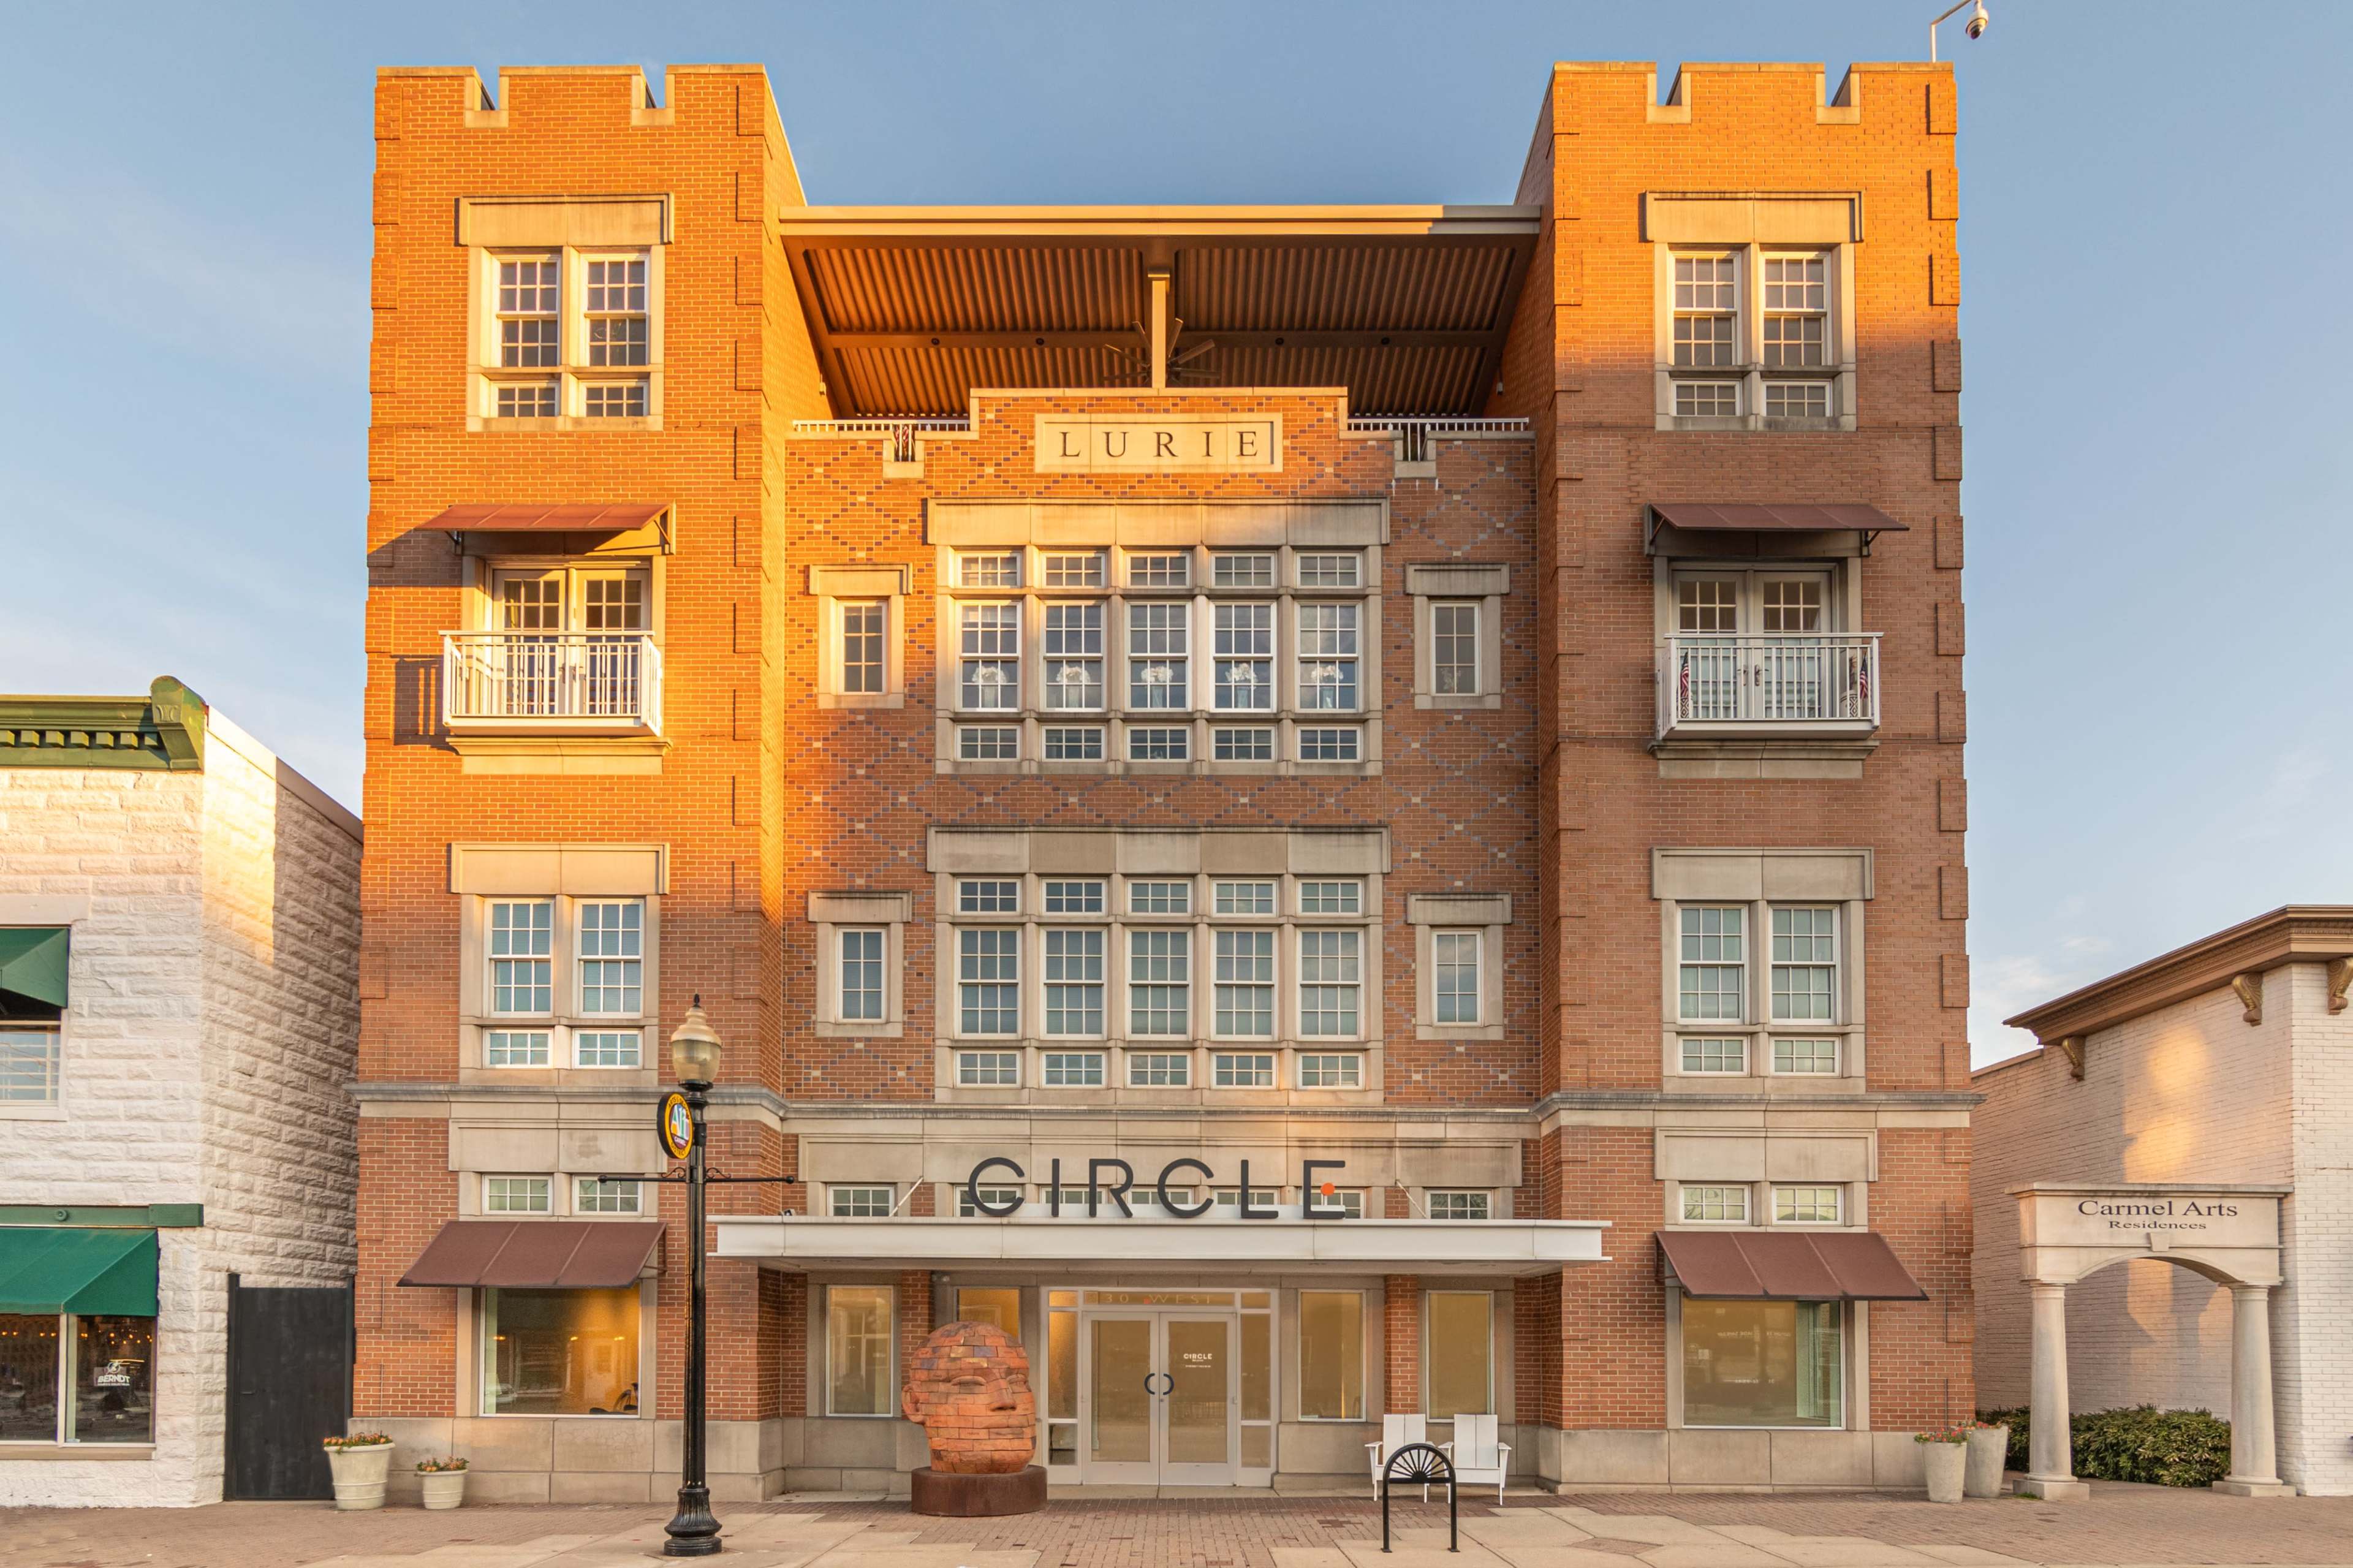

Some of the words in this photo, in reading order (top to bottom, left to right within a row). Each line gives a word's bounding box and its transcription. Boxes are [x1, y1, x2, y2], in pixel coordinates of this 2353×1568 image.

[1059, 431, 1258, 458] LURIE
[968, 1157, 1346, 1219] CIRCLE
[2078, 1200, 2173, 1216] Carmel
[2181, 1201, 2238, 1217] Arts
[2109, 1221, 2207, 1230] Residences
[1104, 1293, 1129, 1303] 30
[97, 1374, 131, 1383] BERNDT
